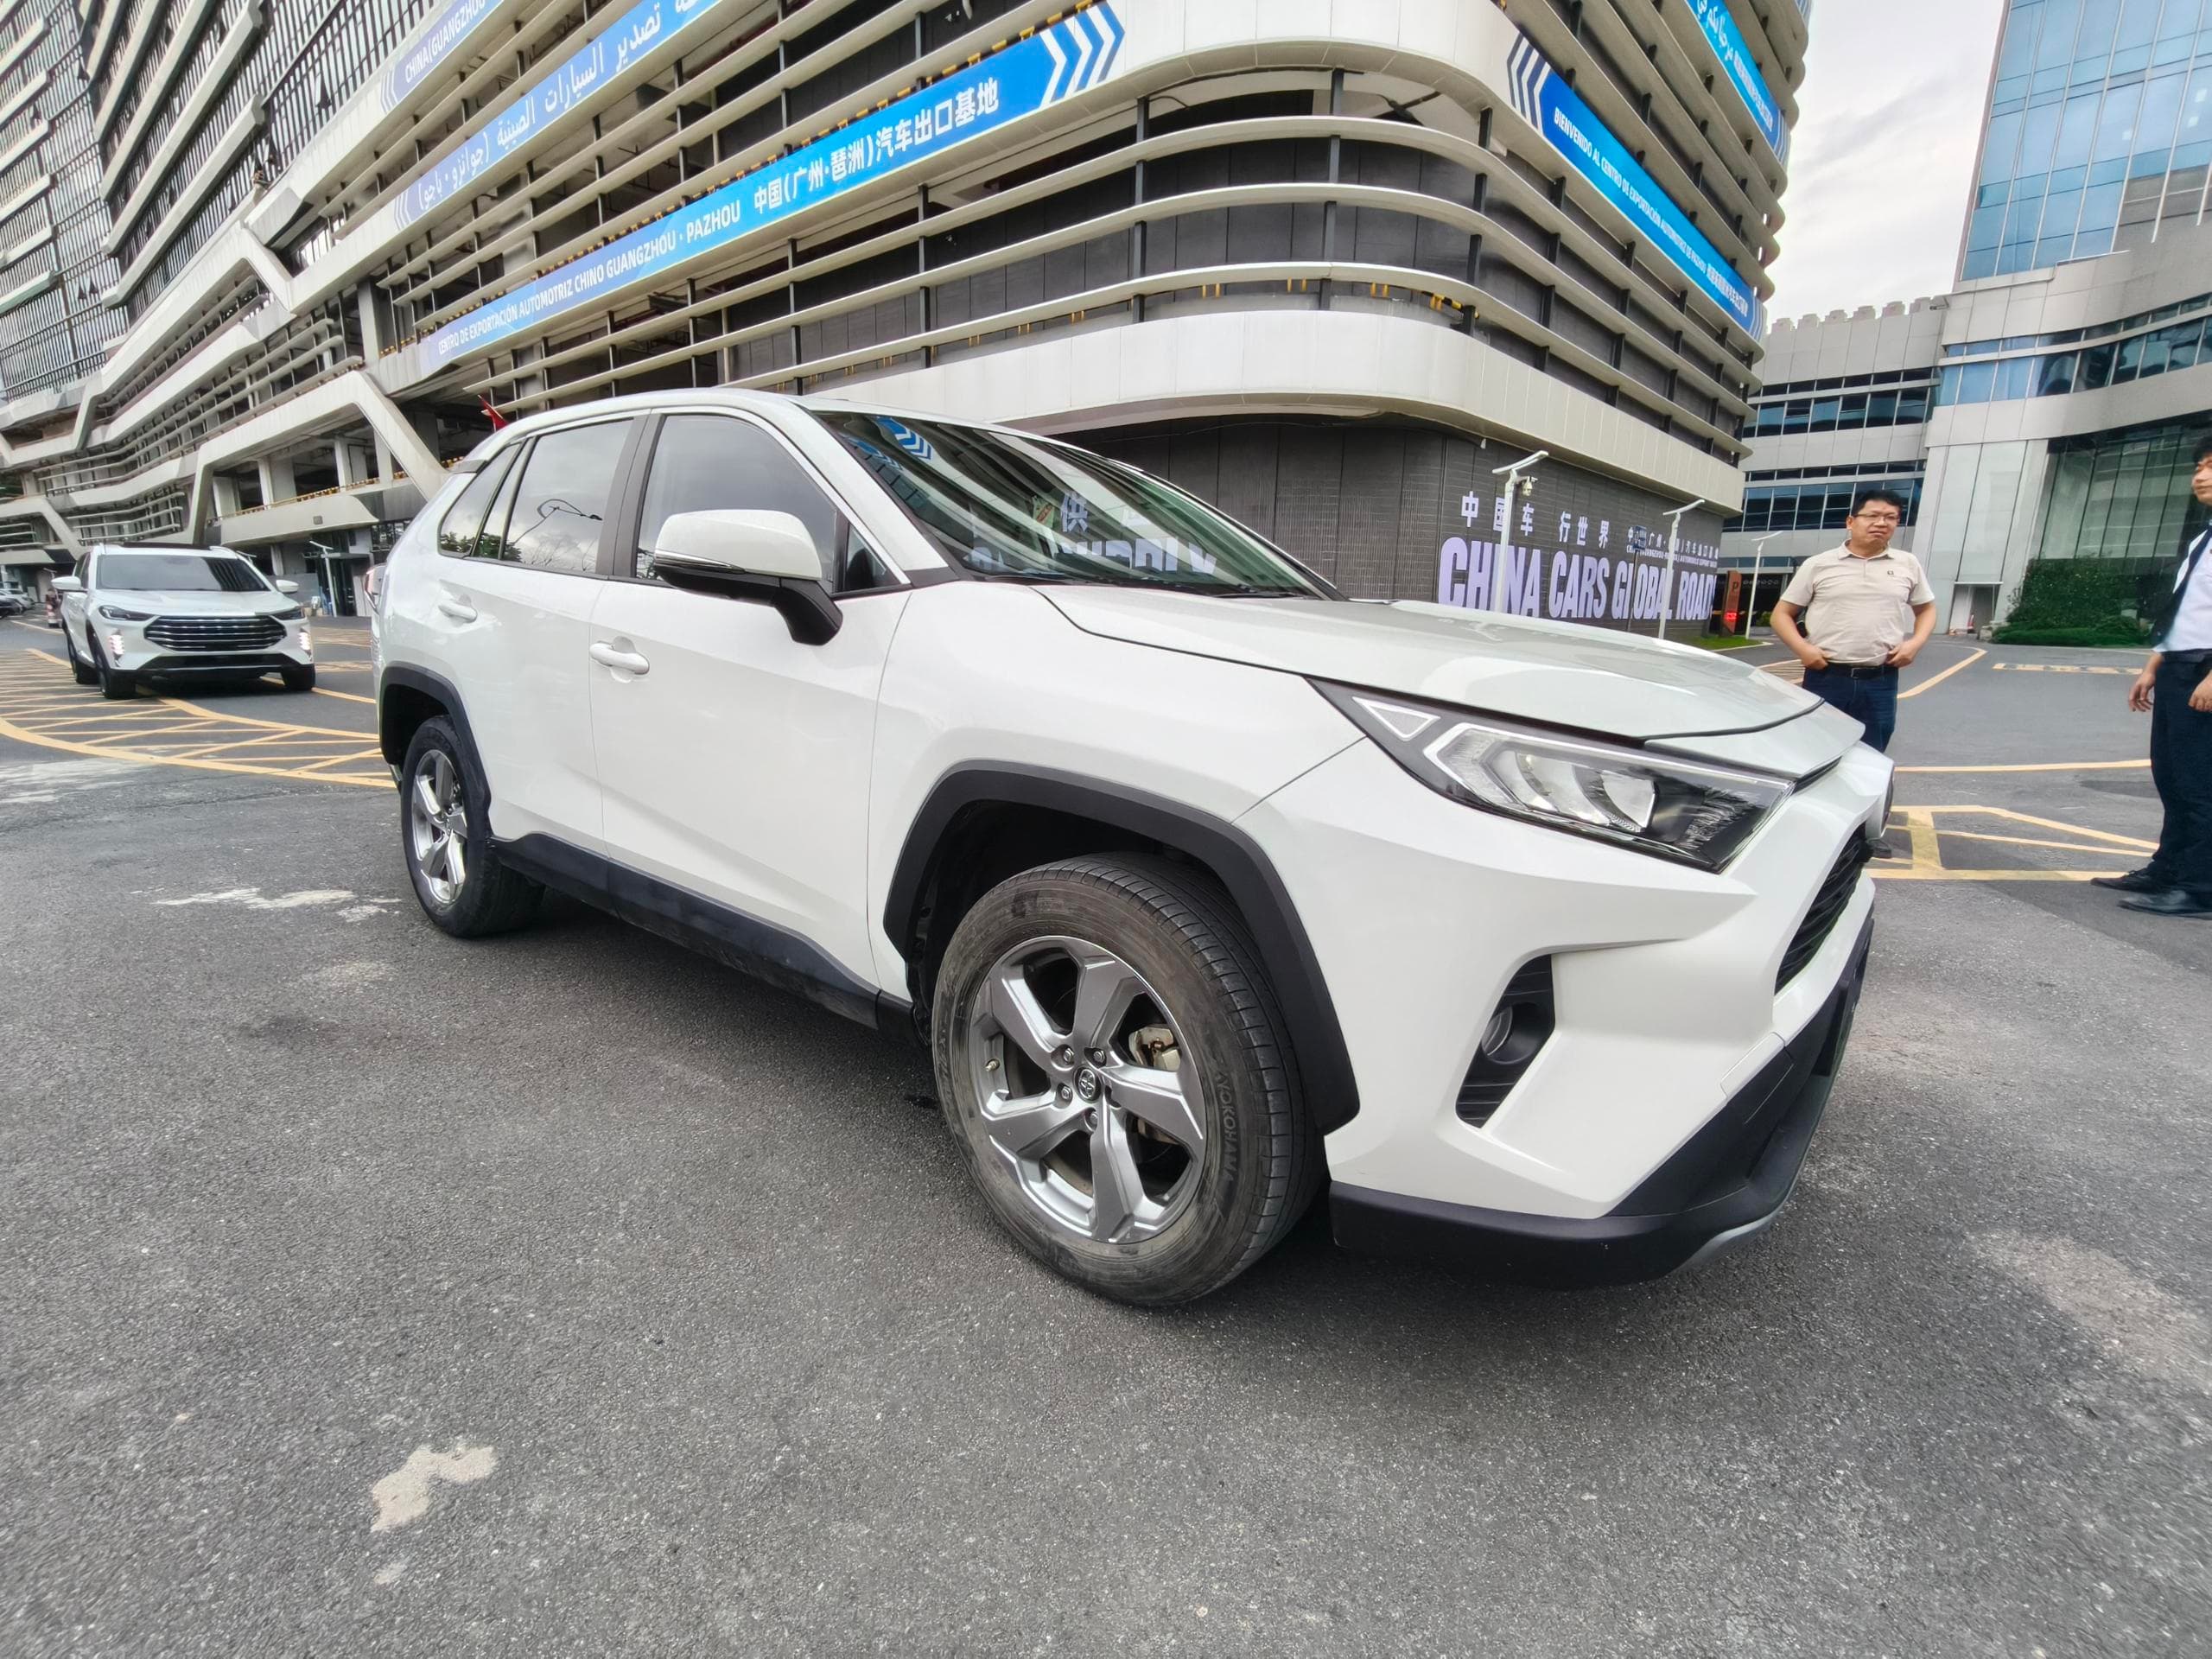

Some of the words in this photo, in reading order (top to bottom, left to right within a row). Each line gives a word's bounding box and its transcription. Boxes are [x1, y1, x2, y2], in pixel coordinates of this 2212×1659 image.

[615, 2, 661, 72] تصدير
[544, 41, 604, 113] السيارات
[1553, 105, 1592, 159] BIENVENIDO
[1592, 148, 1601, 168] AL
[438, 331, 460, 355] CENTRO
[460, 327, 469, 345] DE
[469, 303, 518, 340] EXPORTACIÓN
[518, 272, 574, 317] AUTOMOTRIZ
[574, 264, 606, 293] CHINO
[606, 229, 677, 279] GUANGZHOU
[686, 199, 741, 245] PAZHOU
[1559, 511, 1610, 550] 行世界
[1438, 537, 1541, 618] CHINA
[1548, 550, 1610, 620] CARS
[1216, 1080, 1238, 1182] YOKOHAMA
